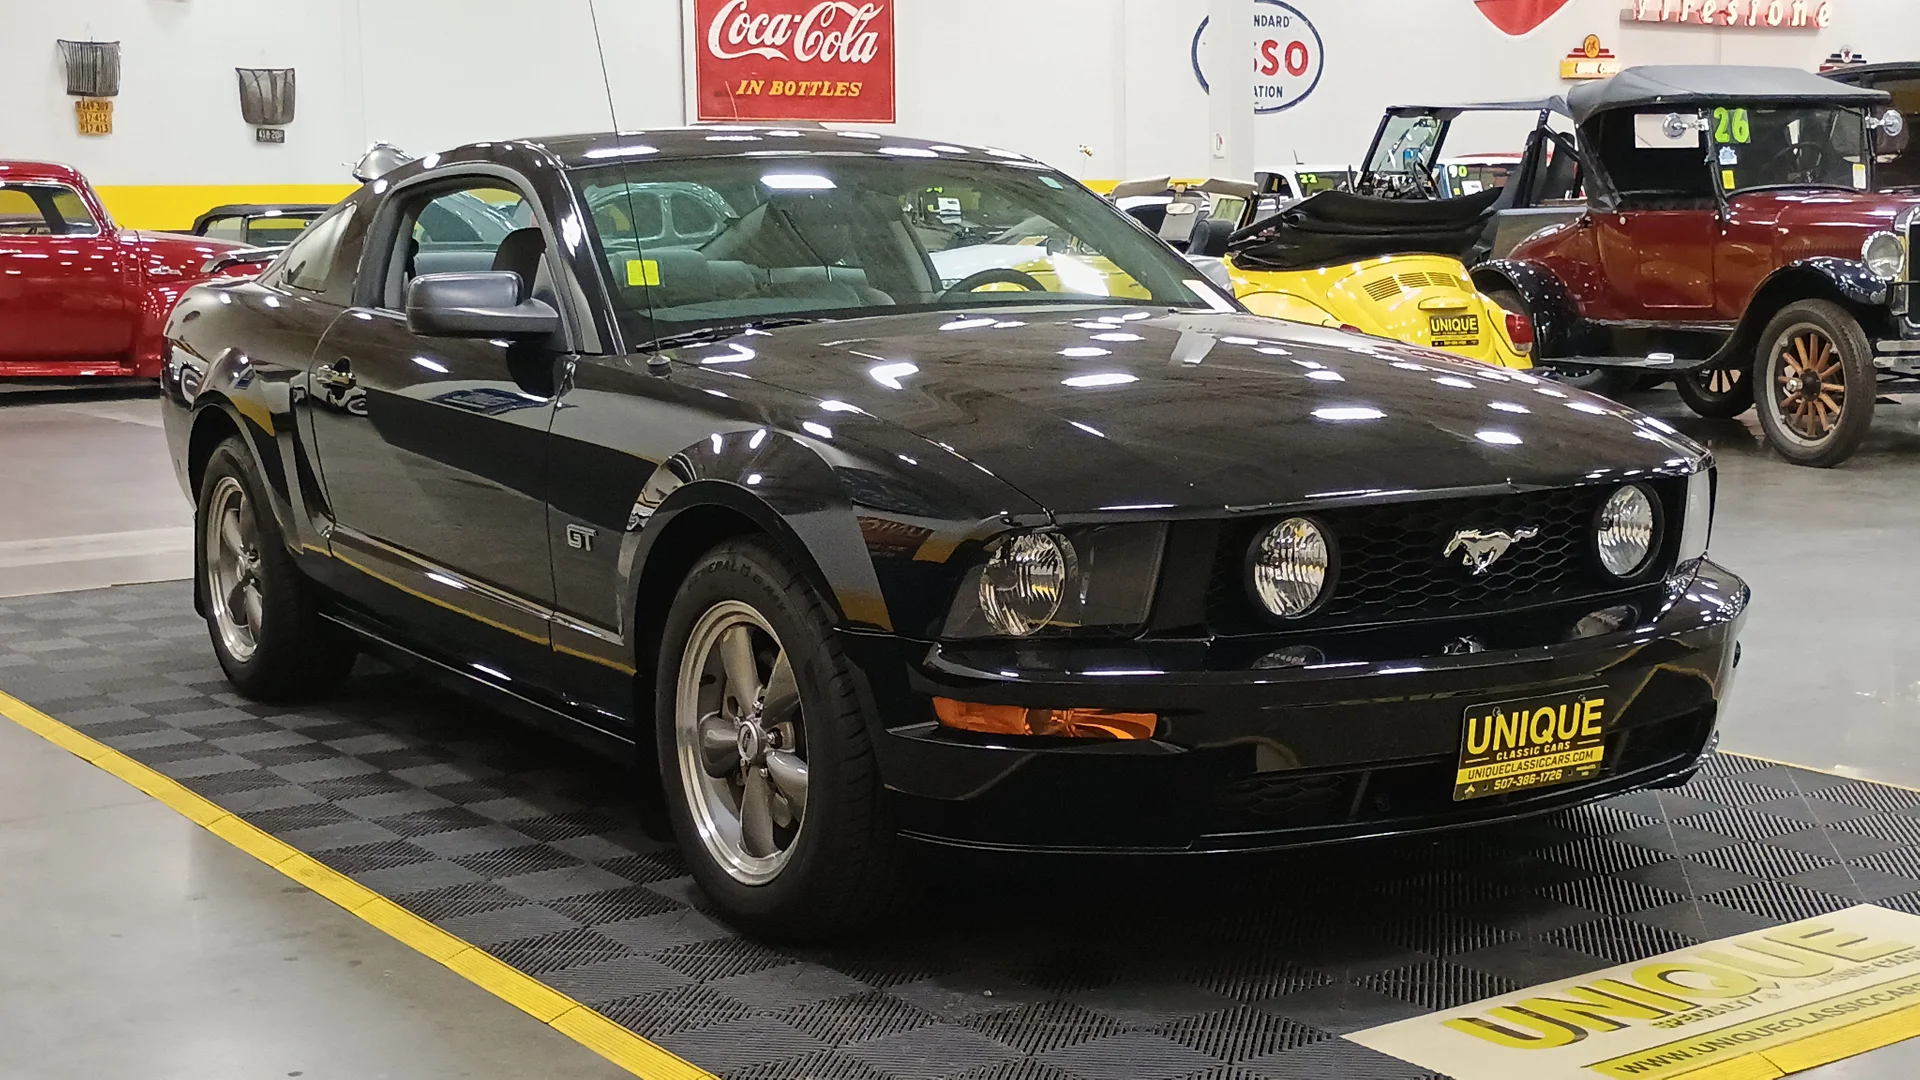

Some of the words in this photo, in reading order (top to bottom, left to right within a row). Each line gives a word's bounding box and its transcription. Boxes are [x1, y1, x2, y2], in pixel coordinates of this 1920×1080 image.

[707, 0, 885, 64] Coca-Cola
[1254, 39, 1308, 77] SO
[736, 79, 765, 96] IN
[768, 80, 863, 97] BOTTLES
[1713, 106, 1750, 144] 26
[1300, 174, 1318, 184] 22
[1430, 316, 1478, 332] UNIQUE
[566, 523, 598, 552] GT
[1467, 698, 1605, 755] UNIQUE
[1467, 749, 1594, 780] UNIQUECLASSICCARS.COM
[1496, 747, 1541, 761] CLASSIC
[1544, 740, 1571, 753] CARS
[1493, 768, 1563, 791] 507-386-1726
[1442, 922, 1916, 1050] UNIQUE
